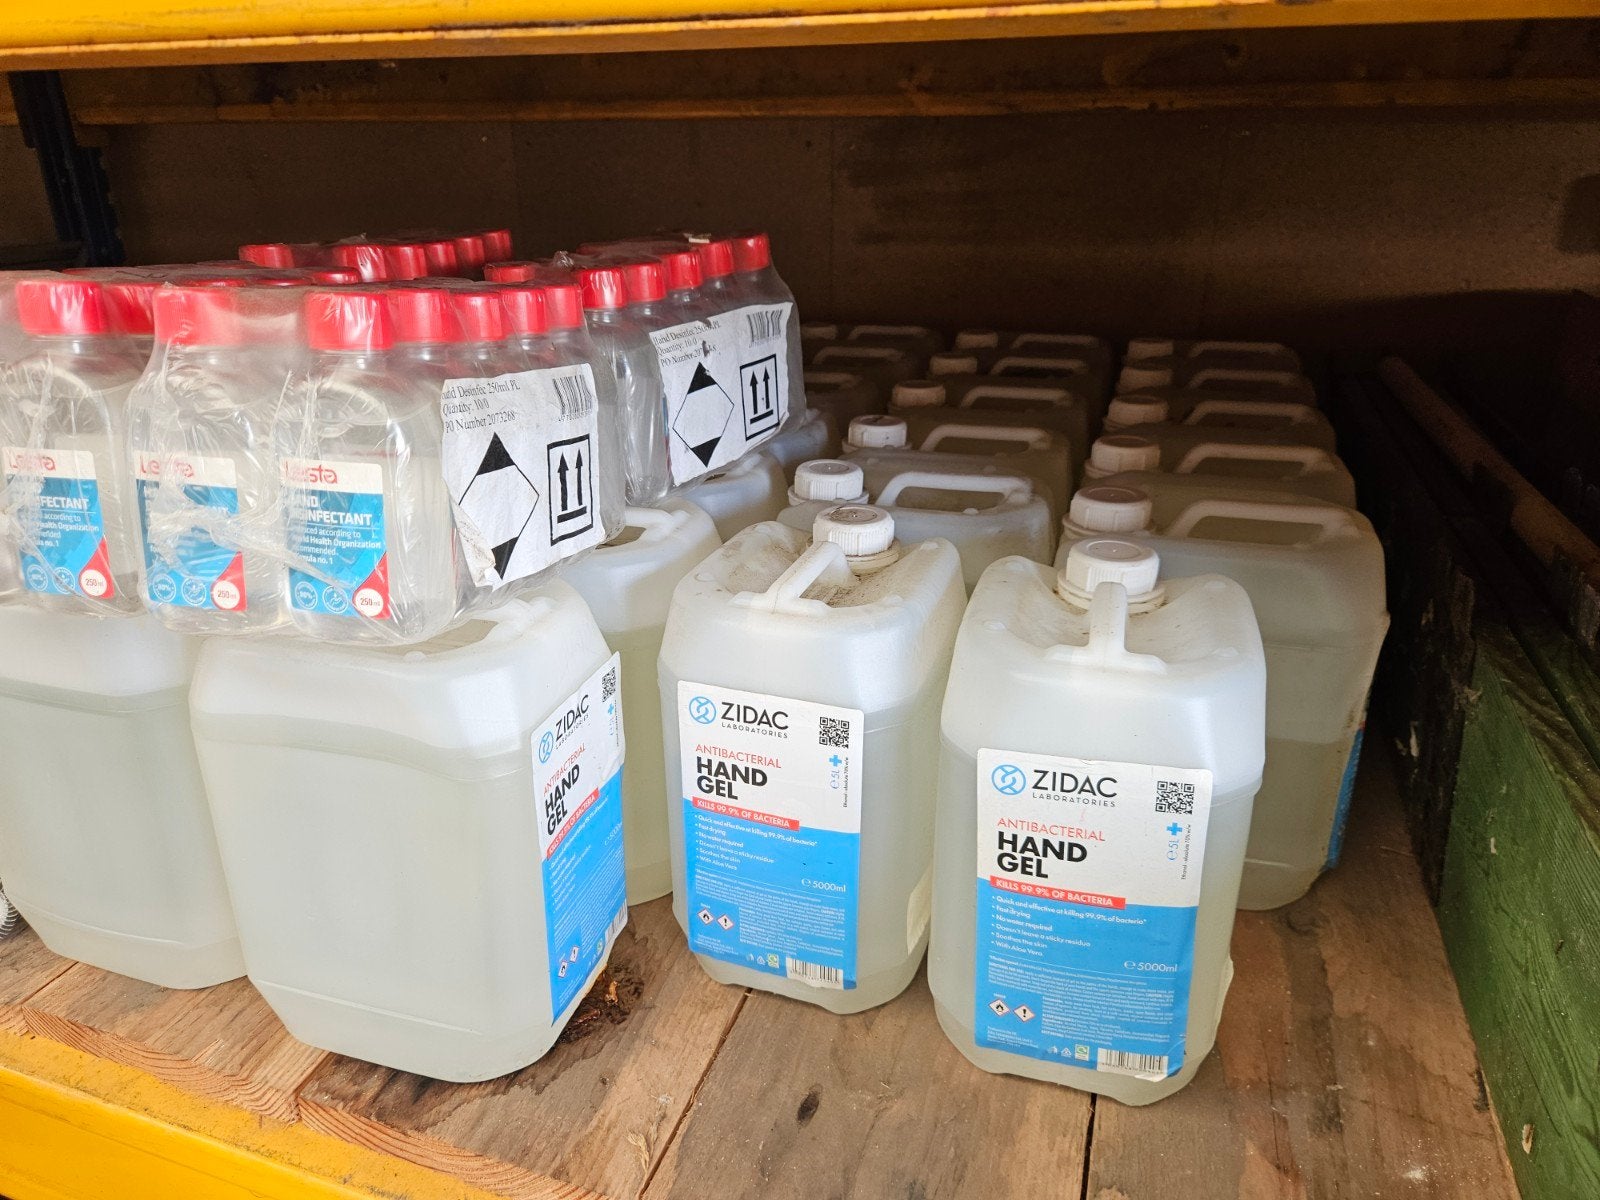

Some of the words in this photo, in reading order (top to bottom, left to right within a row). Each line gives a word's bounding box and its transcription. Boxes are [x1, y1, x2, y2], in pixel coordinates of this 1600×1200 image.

[457, 384, 486, 398] Desinfec
[487, 380, 510, 394] 250ml
[510, 380, 520, 392] PL
[444, 420, 455, 434] PO
[455, 416, 486, 431] Number
[486, 410, 516, 426] 2073268
[310, 536, 332, 546] Health
[334, 538, 381, 549] Organization
[318, 528, 352, 540] according
[85, 578, 97, 586] 250
[217, 590, 230, 598] 250
[360, 597, 372, 606] 250
[556, 694, 589, 742] ZIDAC
[722, 702, 789, 730] ZIDAC
[722, 722, 788, 739] LABORATORIES
[696, 744, 782, 768] ANTIBACTERIAL
[544, 743, 586, 797] ANTIBACTERIAL
[697, 756, 768, 787] HAND
[546, 764, 580, 818] HAND
[697, 776, 738, 800] GEL
[1032, 769, 1118, 798] ZIDAC
[1032, 792, 1116, 808] LABORATORIES
[548, 800, 568, 836] GEL
[697, 800, 715, 810] KILLS
[741, 811, 752, 820] OF
[754, 814, 790, 828] BACTERIA
[752, 828, 768, 838] killing
[996, 816, 1106, 842] ANTIBACTERIAL
[997, 831, 1088, 863] HAND
[997, 852, 1048, 879] GEL
[812, 882, 846, 892] 5000ml
[996, 880, 1018, 891] KILLS
[1020, 884, 1050, 898] 99.9%
[1051, 890, 1065, 900] OF
[1067, 893, 1114, 906] BACTERIA
[996, 896, 1014, 905] Quick
[1028, 903, 1056, 913] effective
[1064, 908, 1085, 919] killing
[1085, 912, 1107, 922] 99.9%
[996, 905, 1010, 914] Fast
[1010, 908, 1031, 919] drying
[1006, 918, 1024, 926] water
[1026, 922, 1053, 932] required
[996, 940, 1010, 950] With
[1046, 935, 1064, 944] sticky
[1136, 962, 1178, 973] 5000ml
